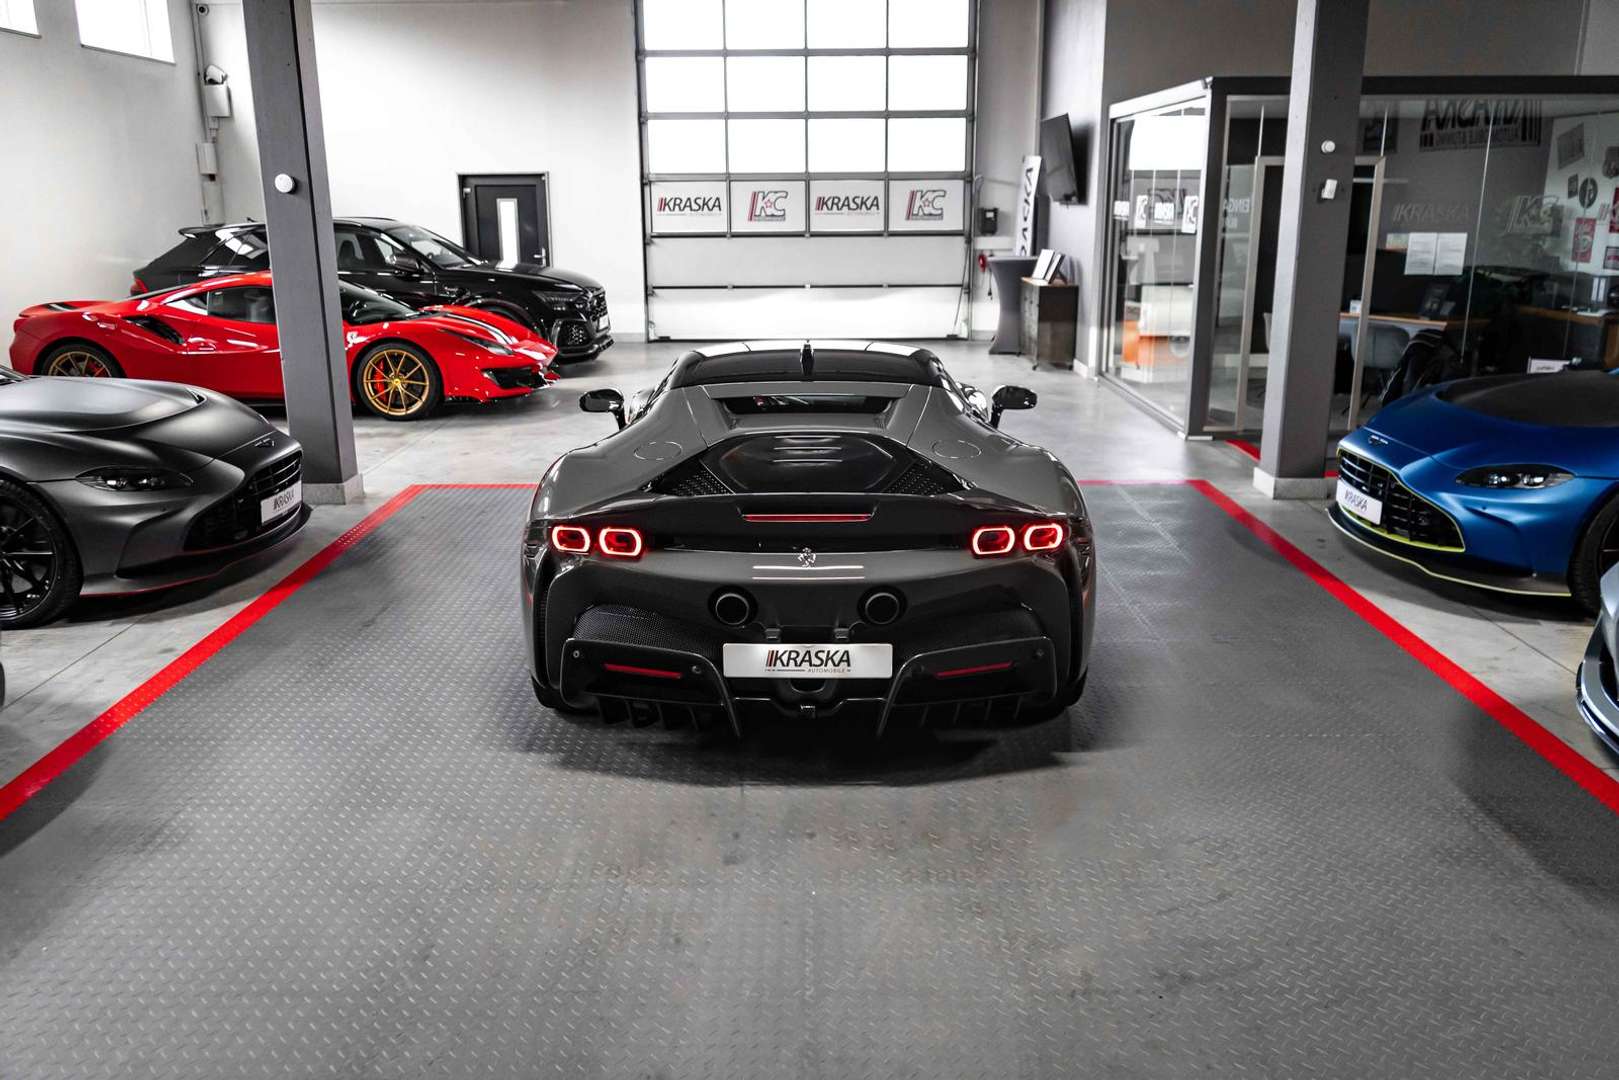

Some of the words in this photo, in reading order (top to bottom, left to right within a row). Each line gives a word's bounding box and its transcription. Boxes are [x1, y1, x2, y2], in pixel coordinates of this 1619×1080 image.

[662, 197, 722, 212] KRASKA
[754, 191, 789, 217] KC
[820, 195, 880, 211] KRASKA
[911, 190, 947, 216] KC
[772, 649, 851, 668] KRASKA
